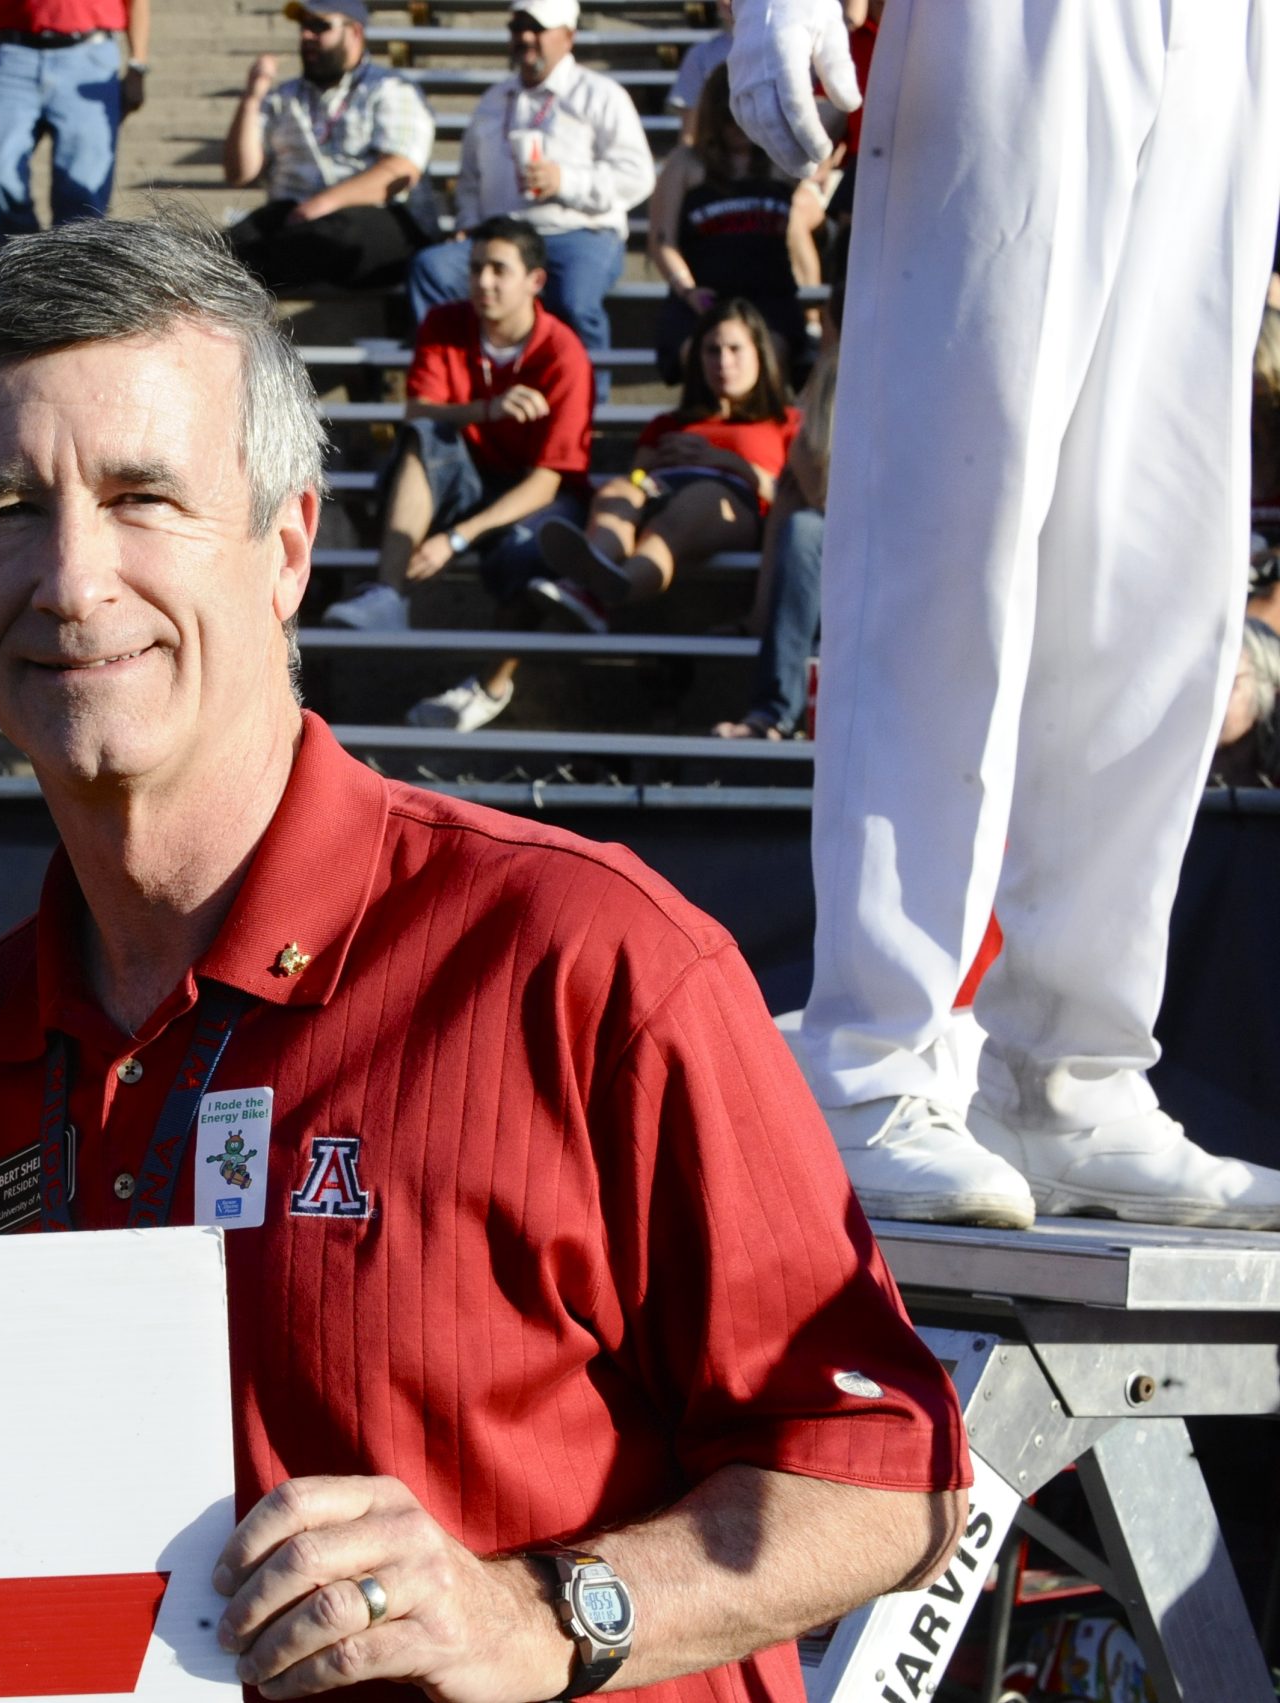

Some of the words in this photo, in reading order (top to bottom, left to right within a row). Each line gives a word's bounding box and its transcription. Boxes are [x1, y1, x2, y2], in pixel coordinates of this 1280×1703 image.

[208, 1102, 213, 1112] I
[214, 1098, 243, 1112] Rode
[245, 1096, 264, 1108] the
[200, 1111, 239, 1124] Energy
[242, 1108, 269, 1120] Bike!
[289, 1137, 369, 1218] A
